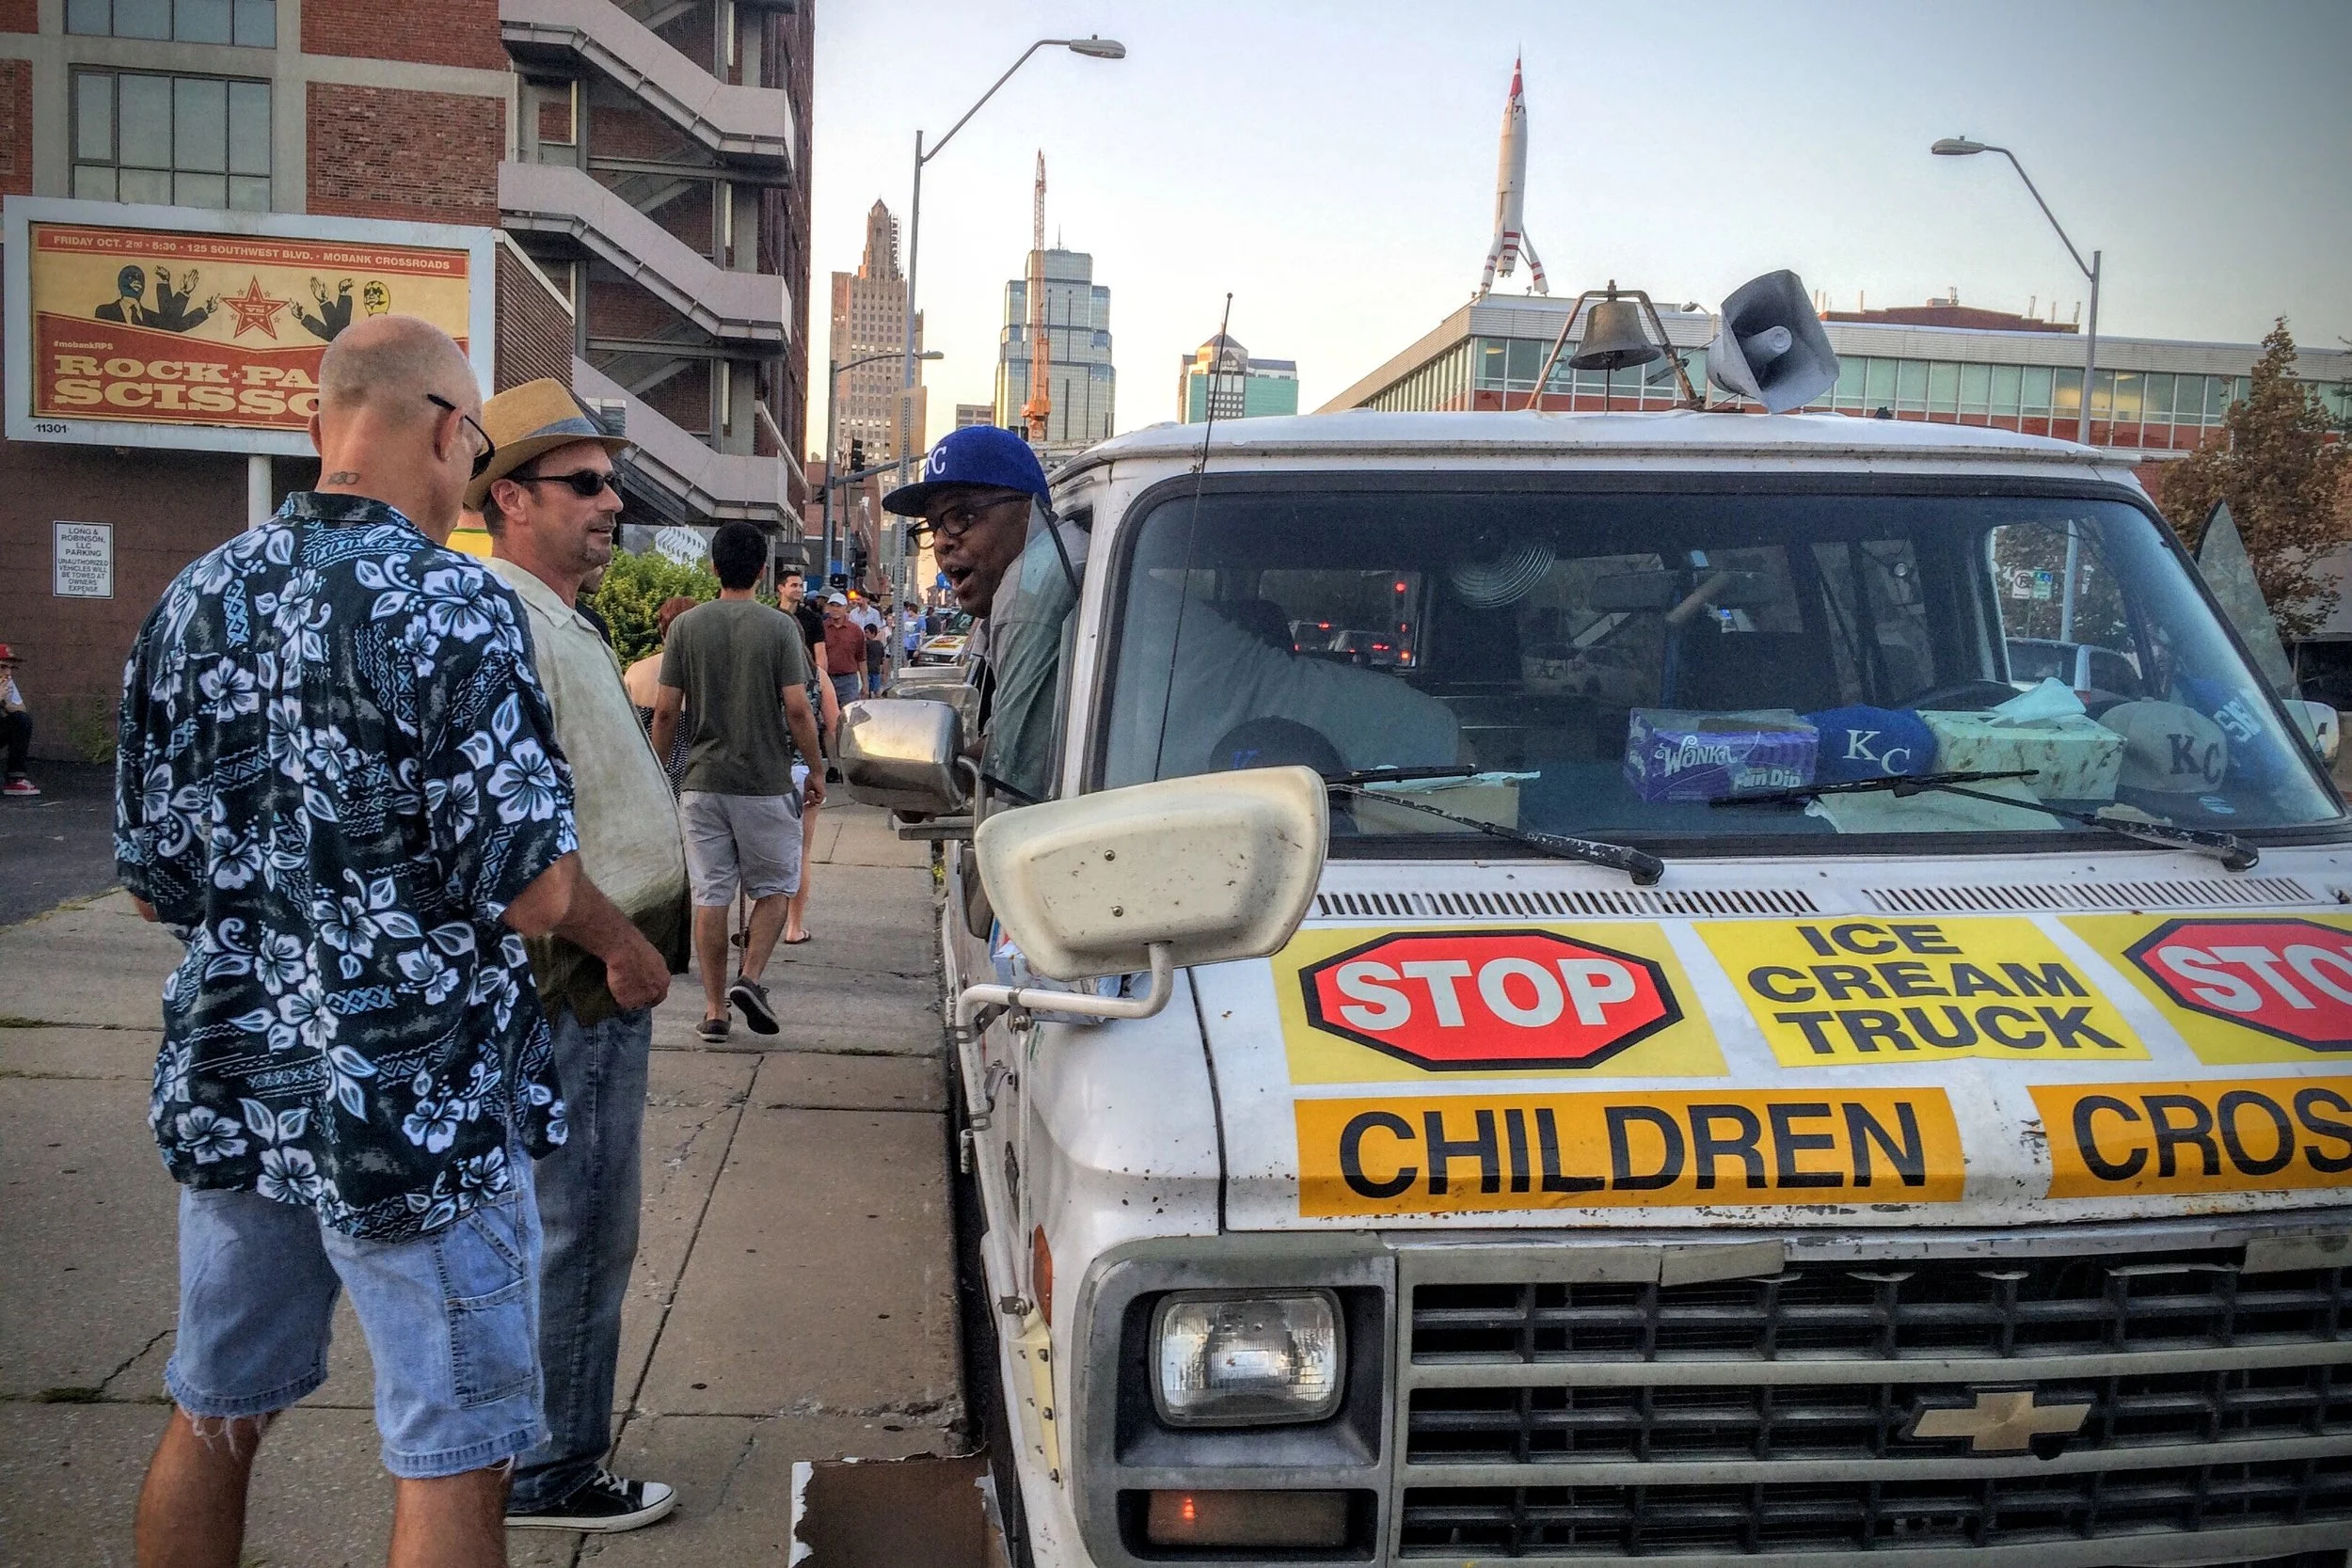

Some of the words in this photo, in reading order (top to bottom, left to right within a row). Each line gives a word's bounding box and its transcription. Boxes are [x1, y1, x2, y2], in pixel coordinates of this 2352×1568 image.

[54, 235, 93, 246] FRIDAY
[97, 237, 122, 247] OCT.
[151, 241, 177, 251] 5:30
[188, 243, 207, 252] 125
[210, 245, 278, 258] SOUTHWEST
[282, 249, 313, 261] BLVD.
[323, 252, 372, 264] MOBANK
[375, 256, 450, 270] CROSSROADS
[54, 341, 114, 350] #mobankRPS
[54, 355, 230, 384] ROCK
[54, 378, 319, 418] SCISSO
[35, 423, 67, 434] 11301
[65, 548, 102, 557] PARKING
[1733, 773, 1767, 792] Fun
[1795, 923, 1964, 958] ICE
[1335, 957, 1637, 1031] STOP
[1746, 960, 2090, 1004] CREAM
[2156, 944, 2352, 1013] STO
[1772, 1005, 2126, 1054] TRUCK
[1338, 1101, 1926, 1199] CHILDREN
[2073, 1087, 2352, 1181] CROS
